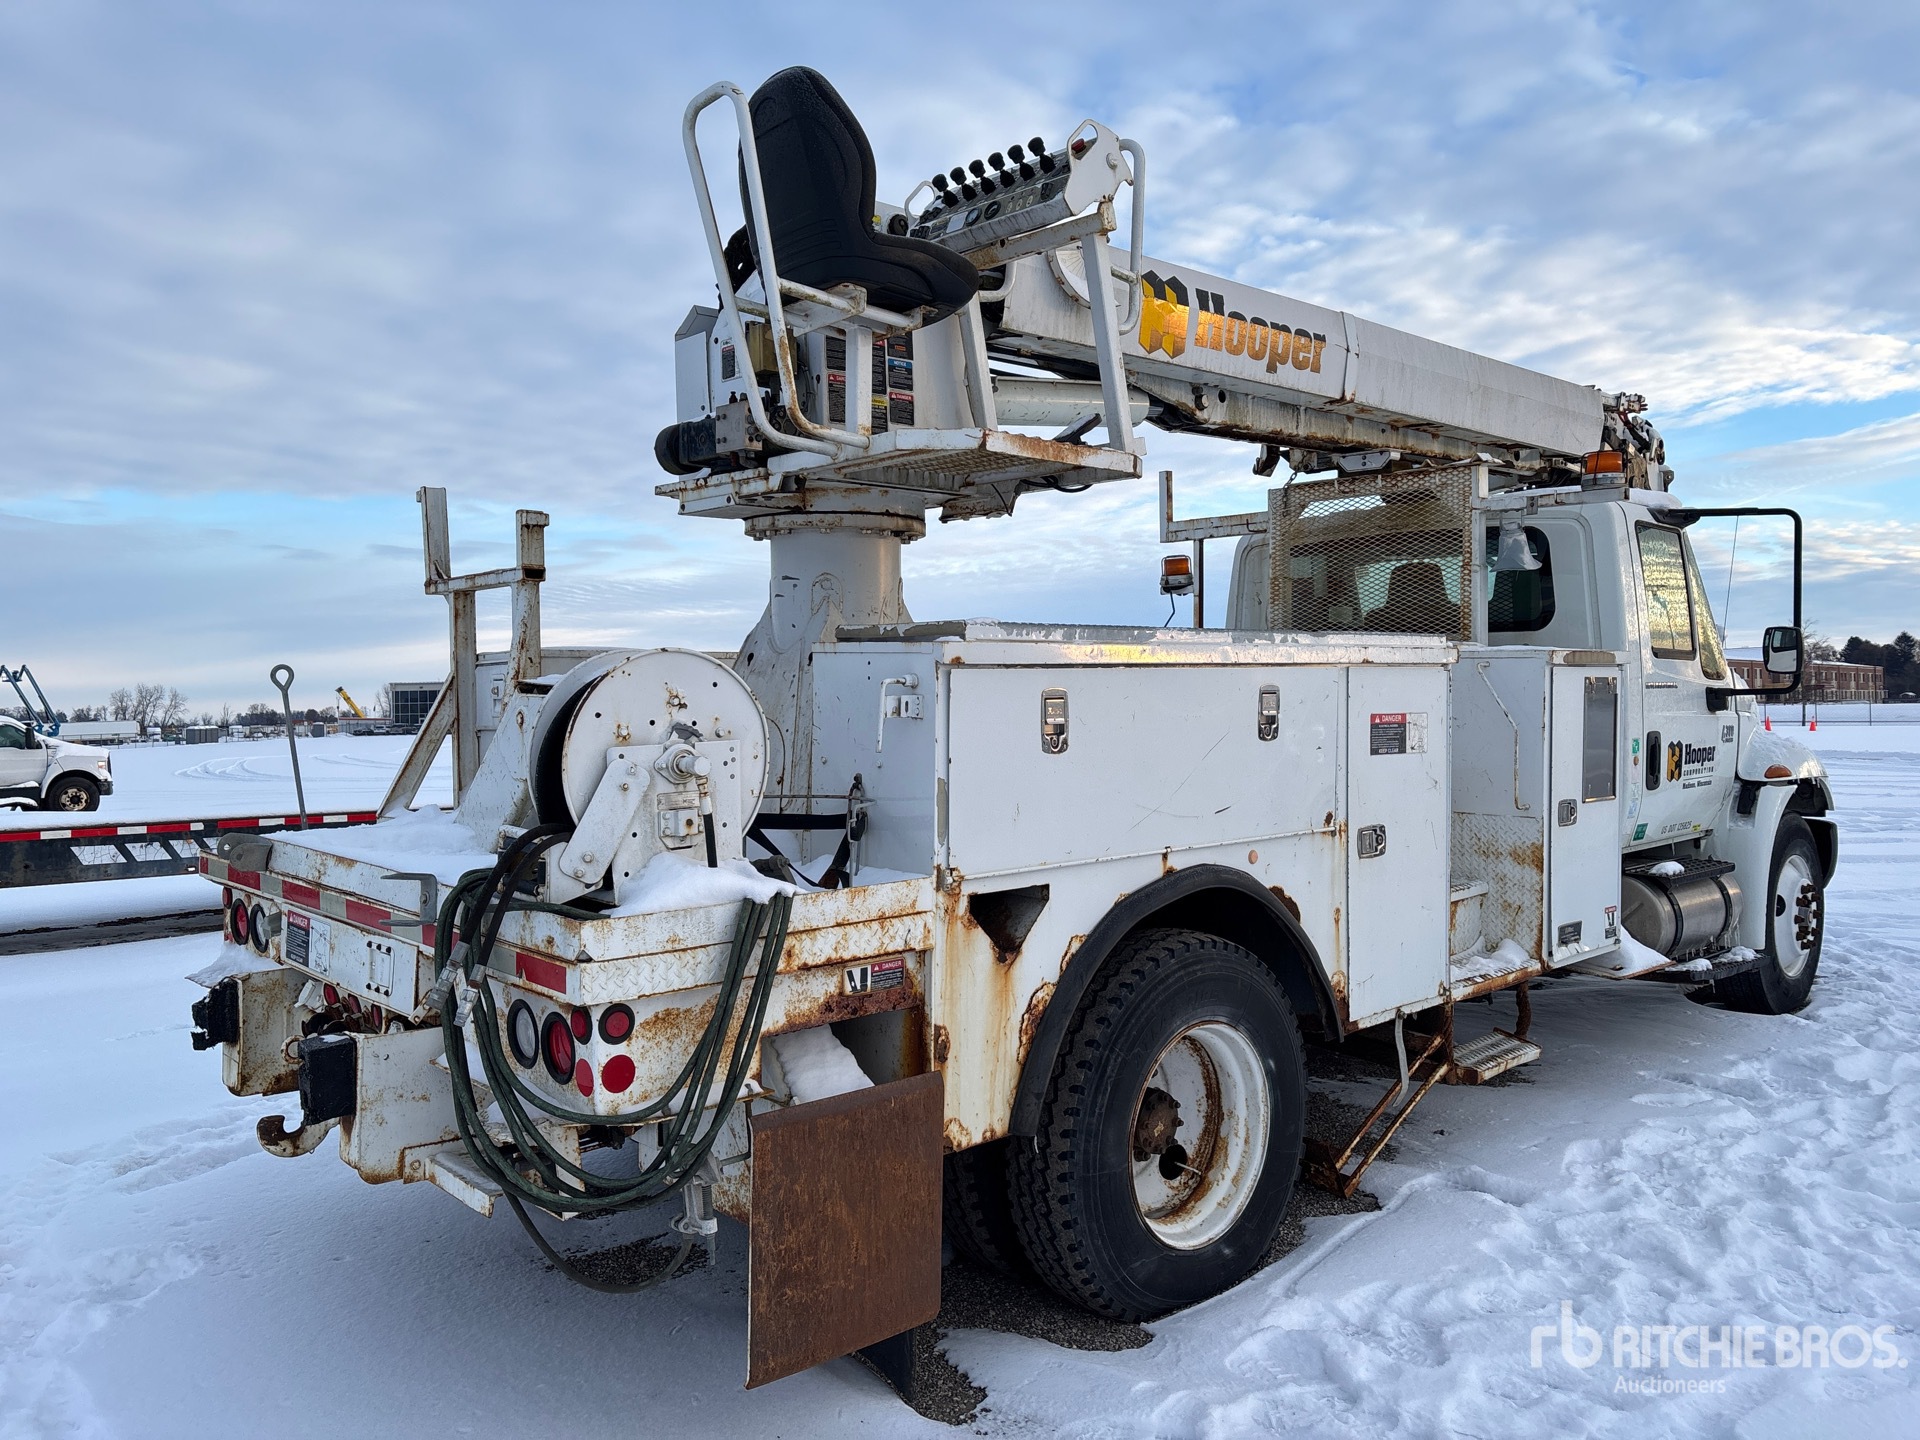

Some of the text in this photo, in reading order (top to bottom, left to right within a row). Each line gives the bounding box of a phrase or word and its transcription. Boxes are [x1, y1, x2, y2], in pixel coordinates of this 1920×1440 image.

[1194, 288, 1326, 374] Hooper
[1684, 743, 1716, 767] Hooper
[293, 914, 308, 927] DANGER
[882, 961, 902, 969] DANGER
